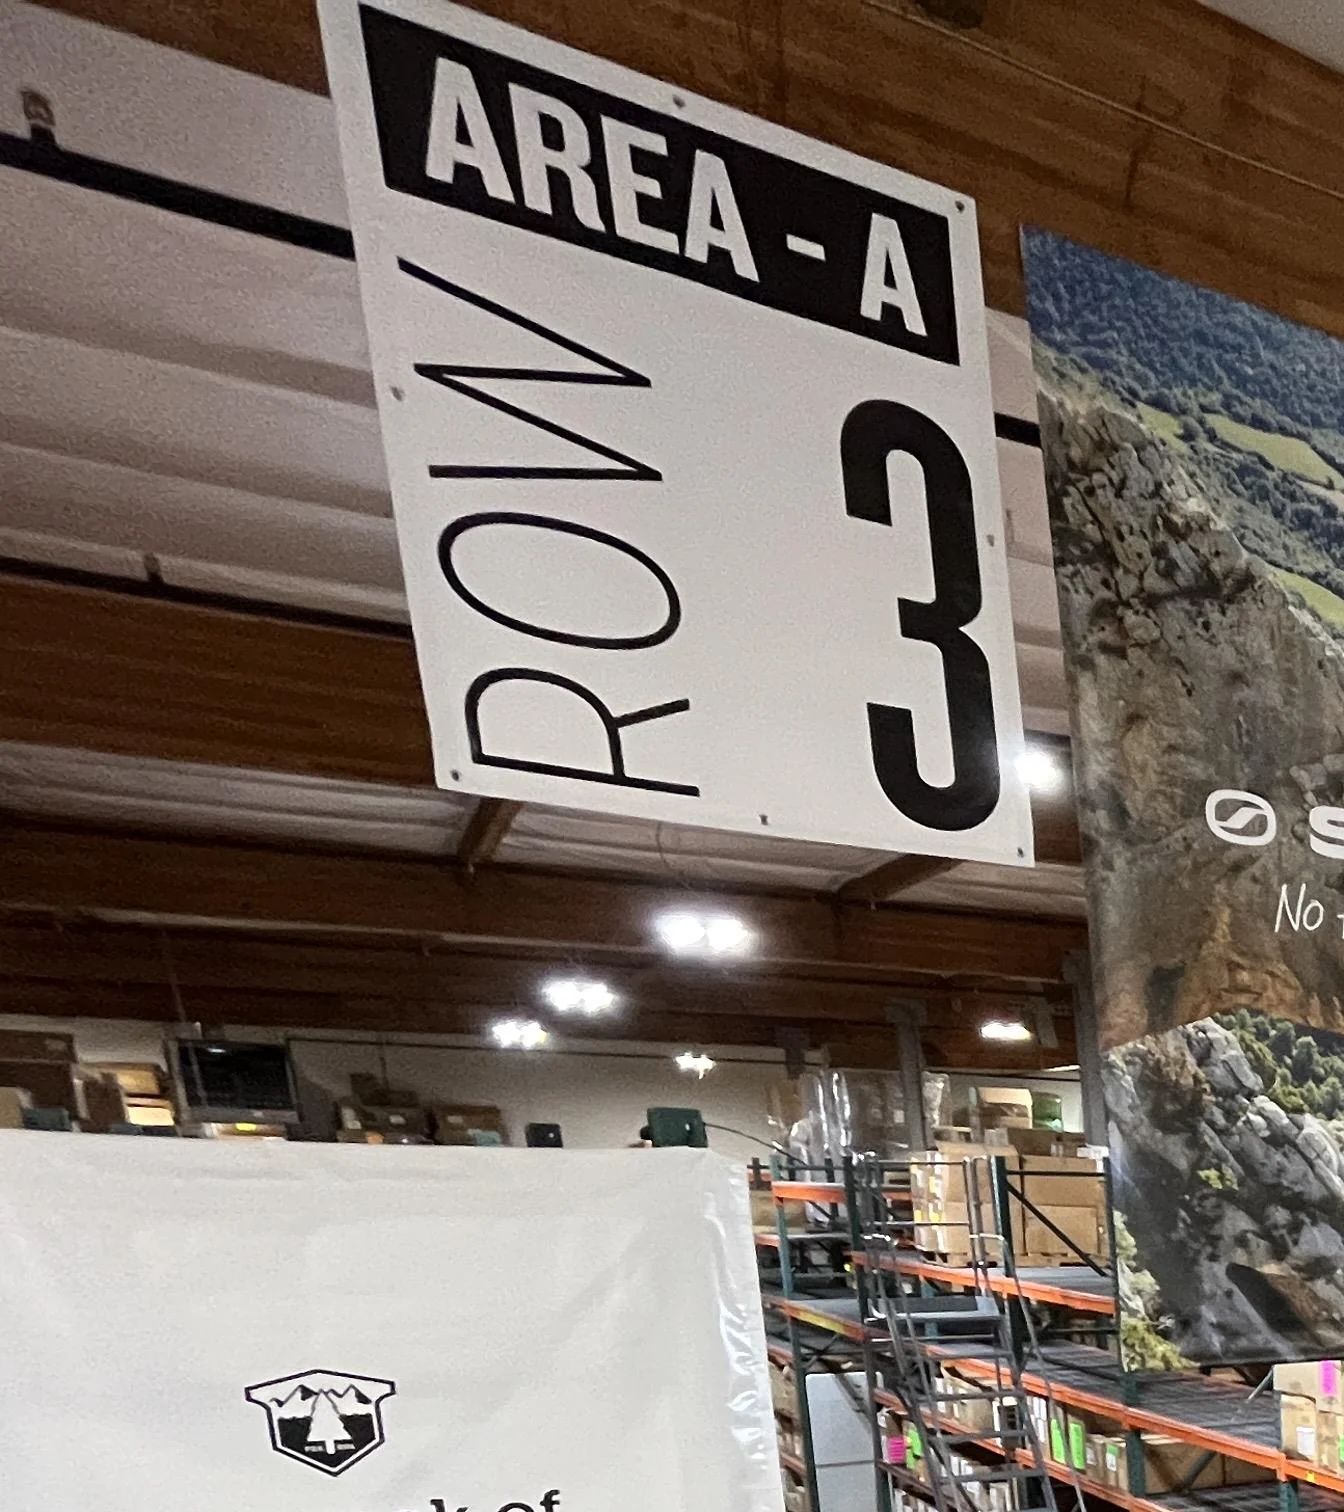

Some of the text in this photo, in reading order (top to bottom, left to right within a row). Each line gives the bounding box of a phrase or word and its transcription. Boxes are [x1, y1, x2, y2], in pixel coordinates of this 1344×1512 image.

[425, 56, 761, 285] AREA
[859, 216, 927, 338] A
[396, 256, 701, 798] ROW
[840, 399, 1002, 832] 3
